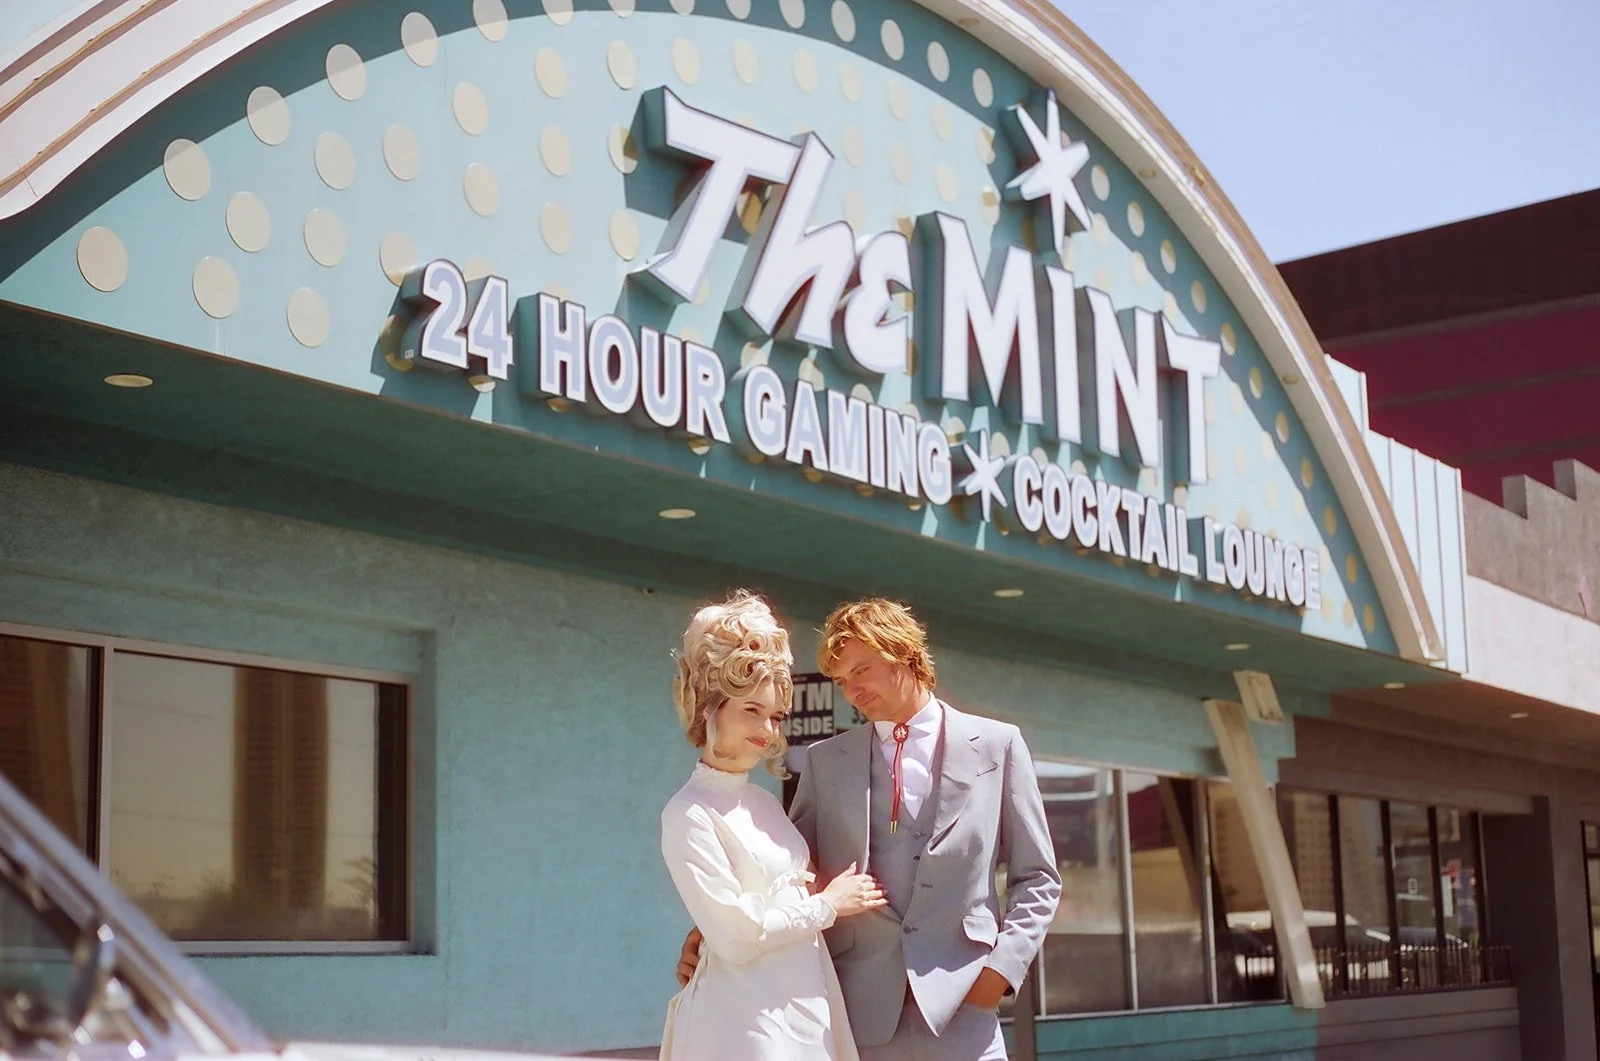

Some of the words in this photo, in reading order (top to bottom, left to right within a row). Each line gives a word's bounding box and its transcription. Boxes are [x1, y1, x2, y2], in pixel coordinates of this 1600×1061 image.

[644, 86, 914, 375] The
[935, 211, 1221, 484] MINT
[421, 259, 514, 380] 24
[538, 293, 731, 443] HOUR
[744, 364, 953, 505] GAMING
[1013, 456, 1199, 577] COCKTAIL
[1203, 517, 1323, 610] LOUNGE
[782, 716, 834, 737] NSIDE
[793, 682, 833, 713] TM
